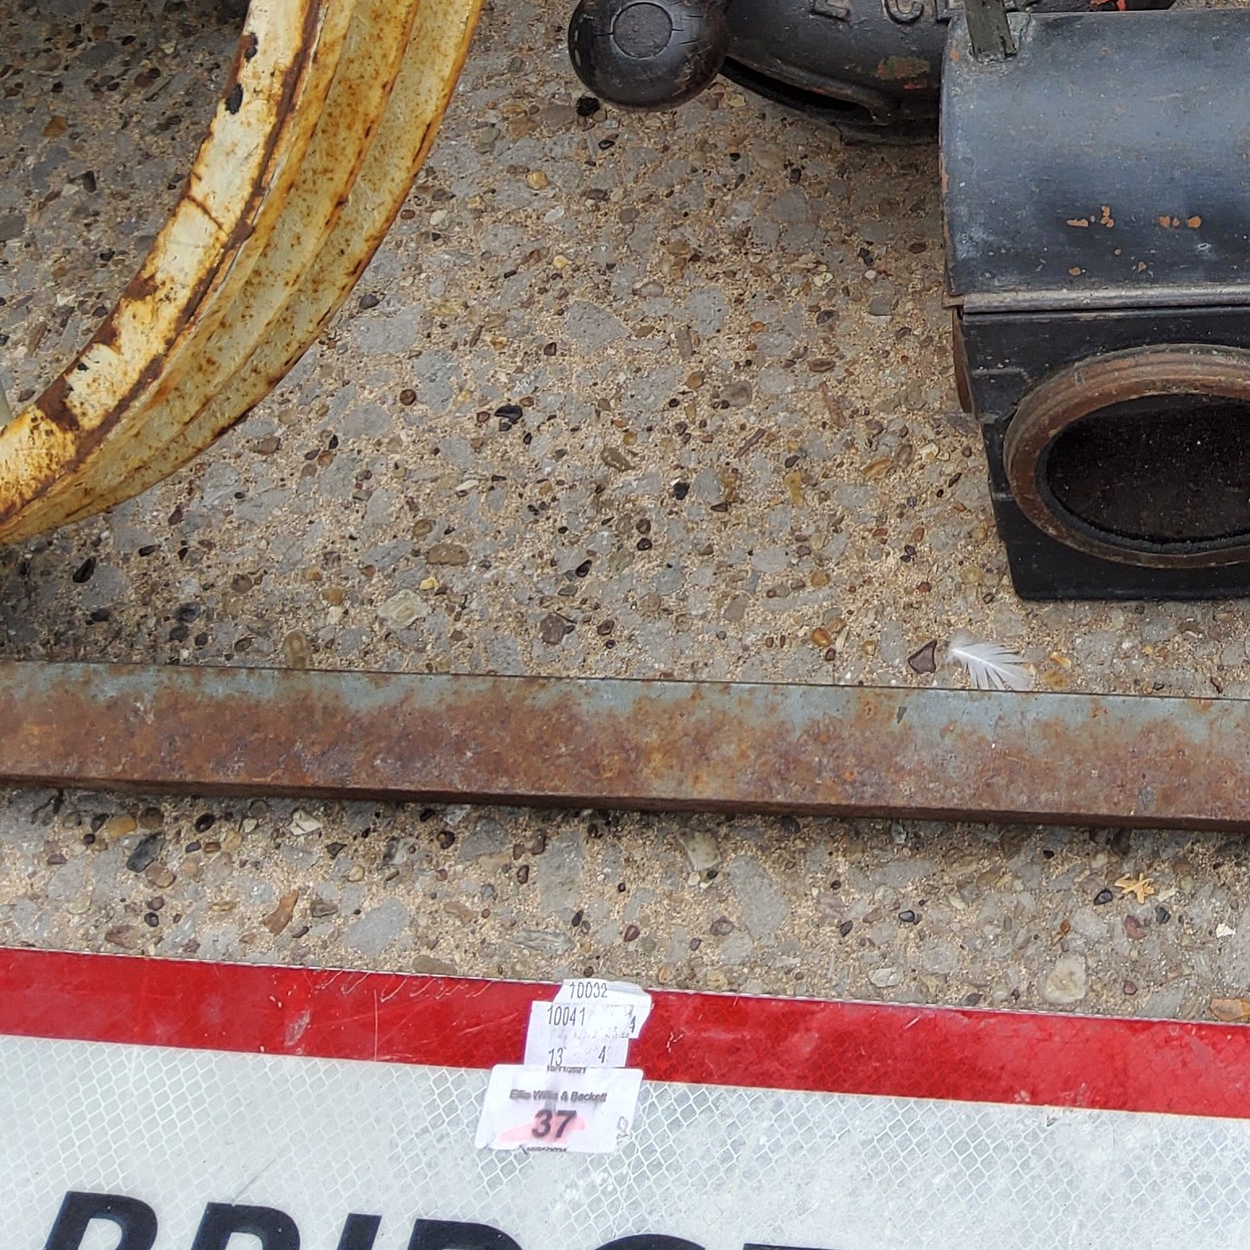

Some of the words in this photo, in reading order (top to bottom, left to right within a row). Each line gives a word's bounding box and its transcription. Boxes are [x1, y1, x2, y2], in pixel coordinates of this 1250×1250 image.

[569, 981, 609, 999] 10032
[547, 1005, 586, 1026] 10041
[548, 1047, 564, 1066] 13
[531, 1109, 577, 1141] 37
